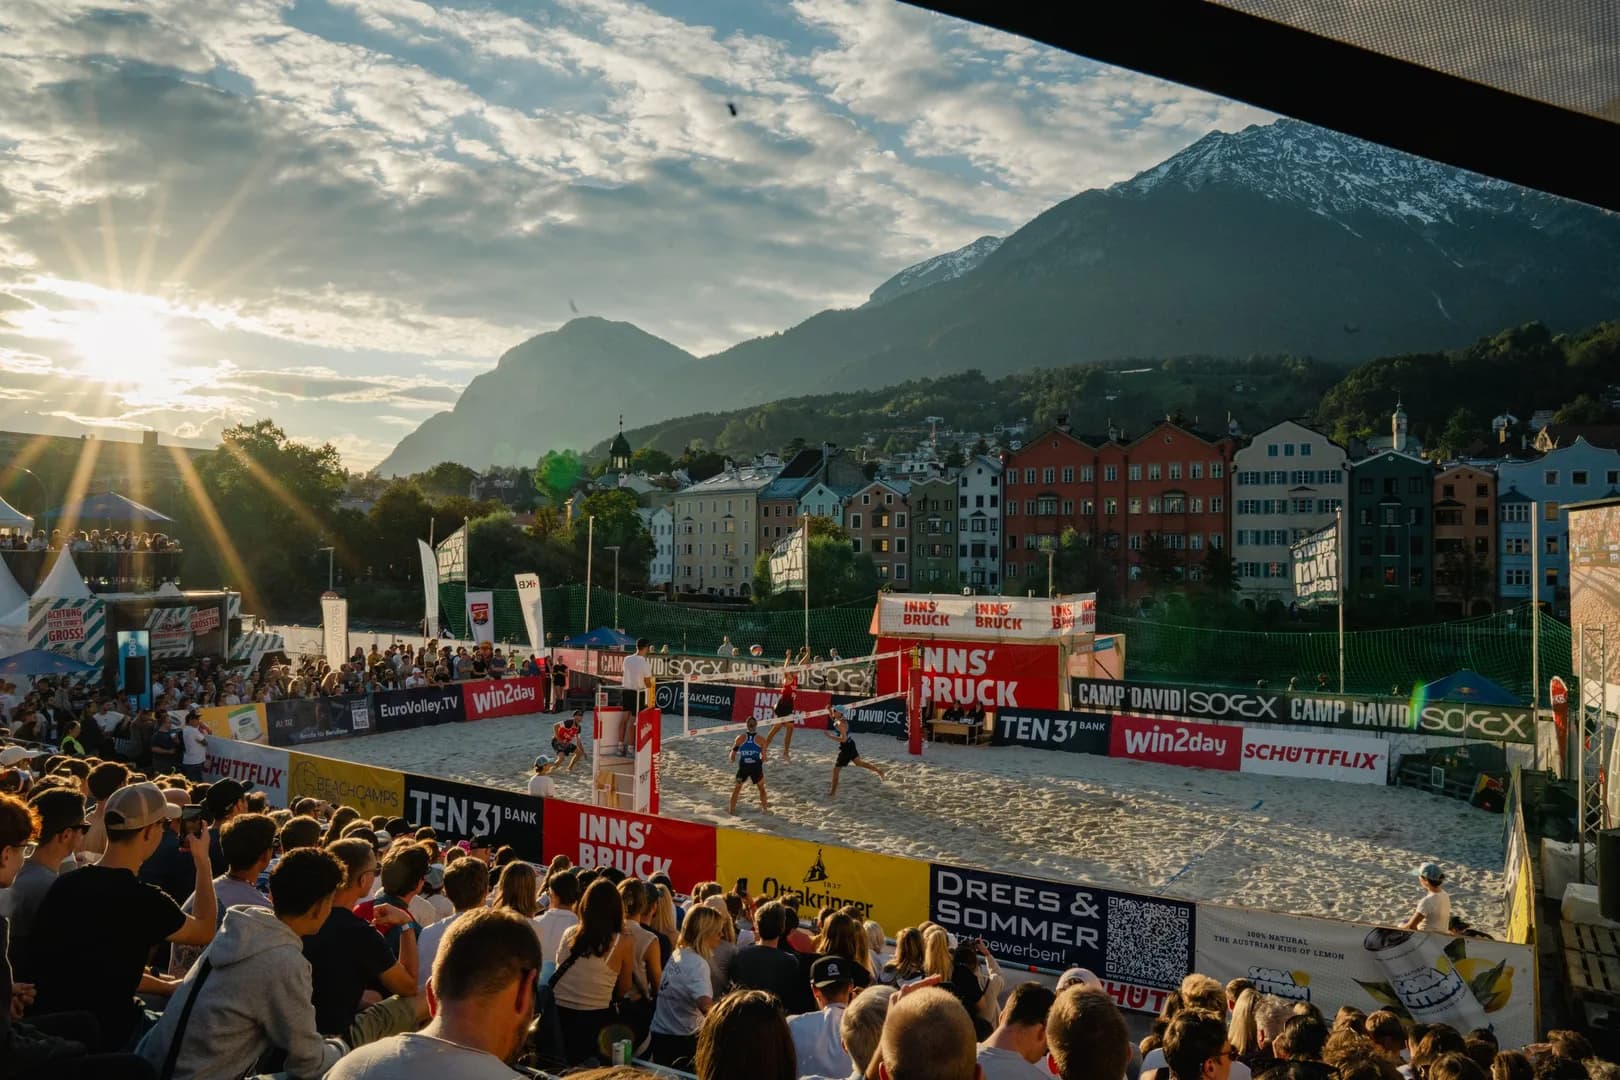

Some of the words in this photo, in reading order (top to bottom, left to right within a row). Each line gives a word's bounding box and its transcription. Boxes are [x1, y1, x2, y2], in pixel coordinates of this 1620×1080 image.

[903, 613, 950, 626] BRUCK
[975, 616, 1023, 630] BRUCK
[49, 627, 84, 642] GROSS!
[923, 646, 995, 676] NNS'
[380, 696, 458, 718] EuroVolley.TV
[1078, 683, 1125, 705] CAMP
[1131, 687, 1182, 711] DAVID
[858, 709, 884, 723] DAVID
[1290, 698, 1345, 723] CAMP
[1352, 702, 1410, 728] DAVID
[1080, 721, 1106, 731] BANK
[203, 752, 282, 789] CHÜTTFLIX
[316, 777, 399, 808] BEACHCAMPS
[504, 807, 537, 825] BANK
[579, 812, 653, 850] INNS'
[1070, 891, 1101, 920] &
[937, 900, 1100, 949] SOMMER
[1214, 935, 1230, 944] THE
[1232, 938, 1276, 950] AUSTRIAN
[1278, 945, 1298, 954] KISS
[1300, 948, 1311, 956] OF
[1313, 950, 1345, 960] LEMON
[1247, 930, 1266, 939] 100%
[1268, 934, 1309, 946] NATURAL
